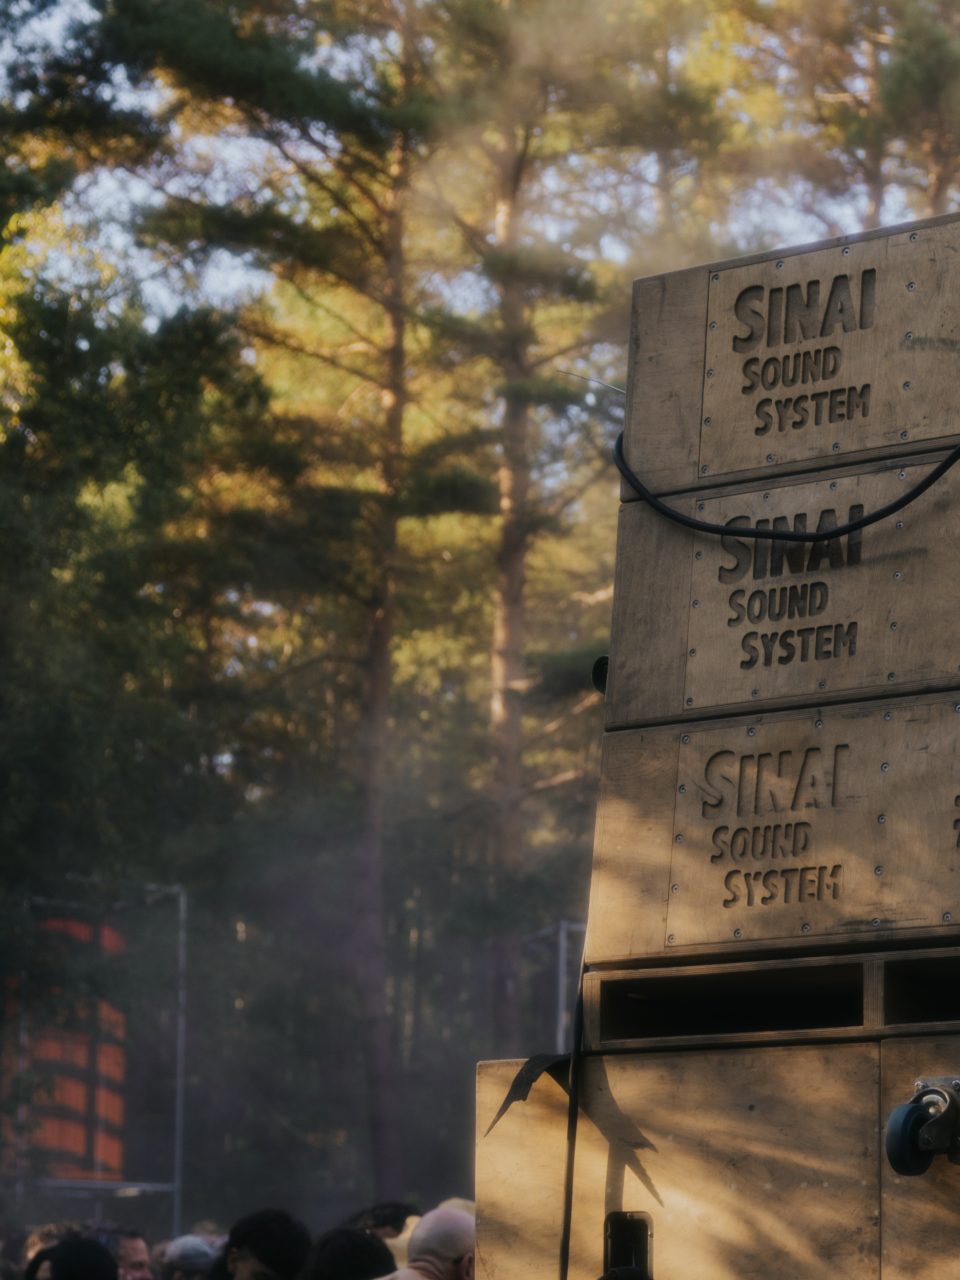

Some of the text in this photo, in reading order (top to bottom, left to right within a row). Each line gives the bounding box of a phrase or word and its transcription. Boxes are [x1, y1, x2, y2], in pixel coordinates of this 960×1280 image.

[733, 268, 876, 354] SINAI
[741, 345, 842, 396] SOUND
[754, 383, 871, 437] SYSTEM
[718, 504, 864, 585] SINAI
[728, 581, 829, 627] SOUND
[740, 621, 858, 670] SYSTEM
[701, 743, 849, 819] SINAI
[710, 821, 812, 864] SOUND
[723, 864, 843, 909] SYSTEM
